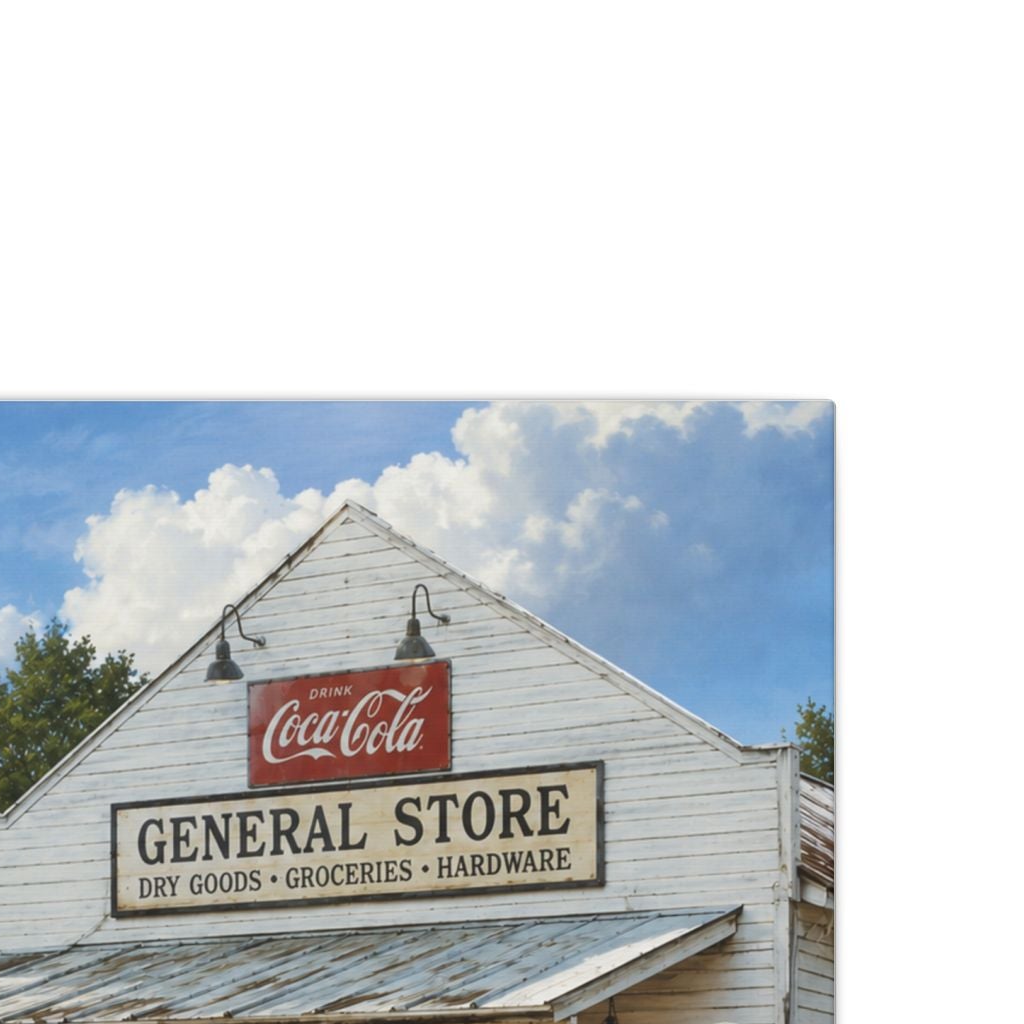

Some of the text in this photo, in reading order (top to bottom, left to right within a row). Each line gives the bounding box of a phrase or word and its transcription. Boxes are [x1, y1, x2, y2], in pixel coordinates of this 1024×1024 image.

[309, 684, 353, 700] DRINK
[262, 686, 433, 764] Coca-Cola
[137, 784, 571, 865] GENERAL STORE
[139, 848, 572, 899] DRY GOODS GROCERIES HARDWARE
